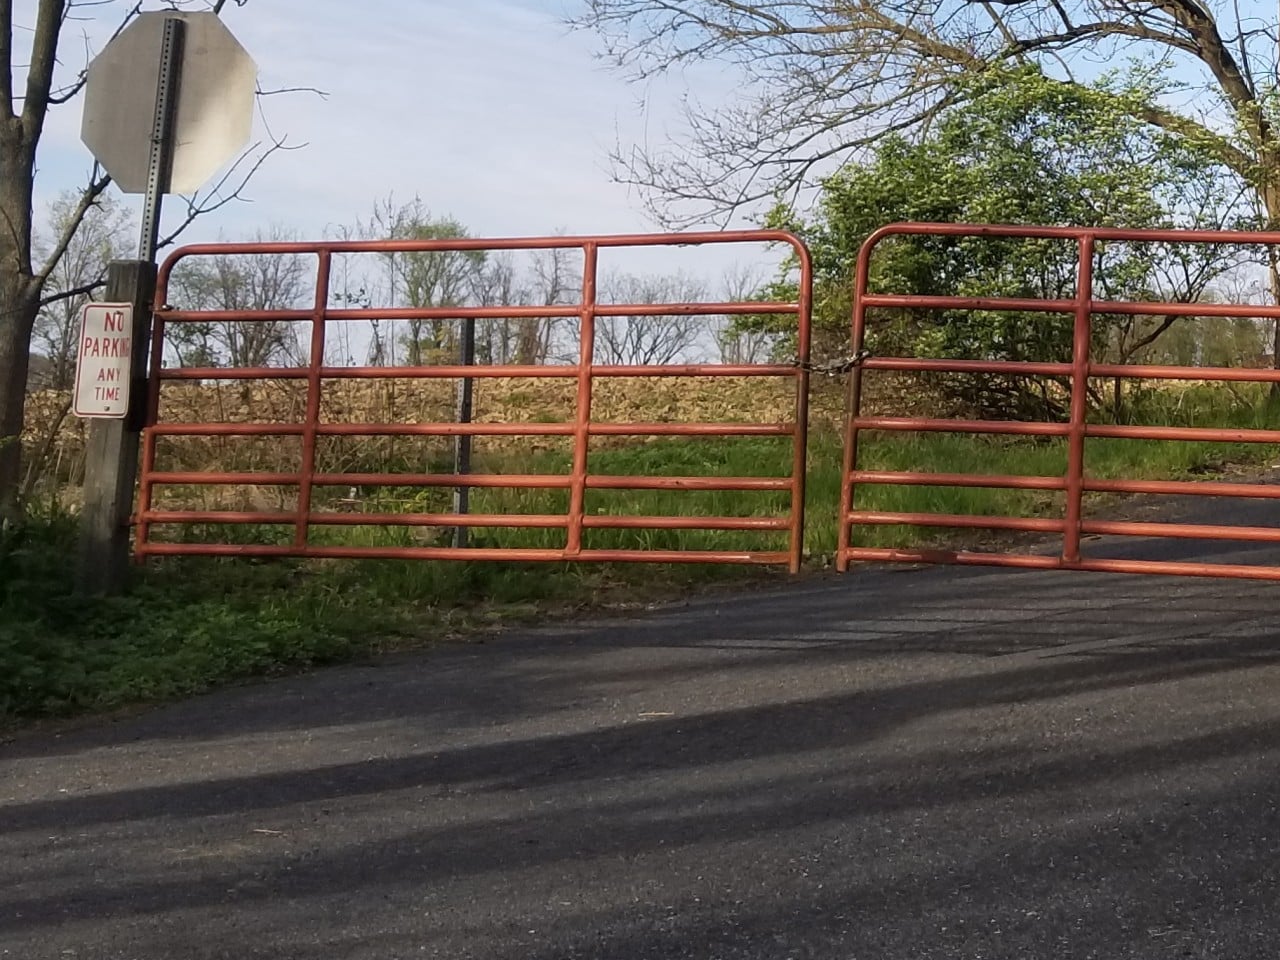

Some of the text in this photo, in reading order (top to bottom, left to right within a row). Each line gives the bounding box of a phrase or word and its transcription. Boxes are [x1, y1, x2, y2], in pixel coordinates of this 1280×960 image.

[104, 311, 124, 332] NO
[97, 368, 121, 381] ANY
[95, 387, 120, 400] TIME
